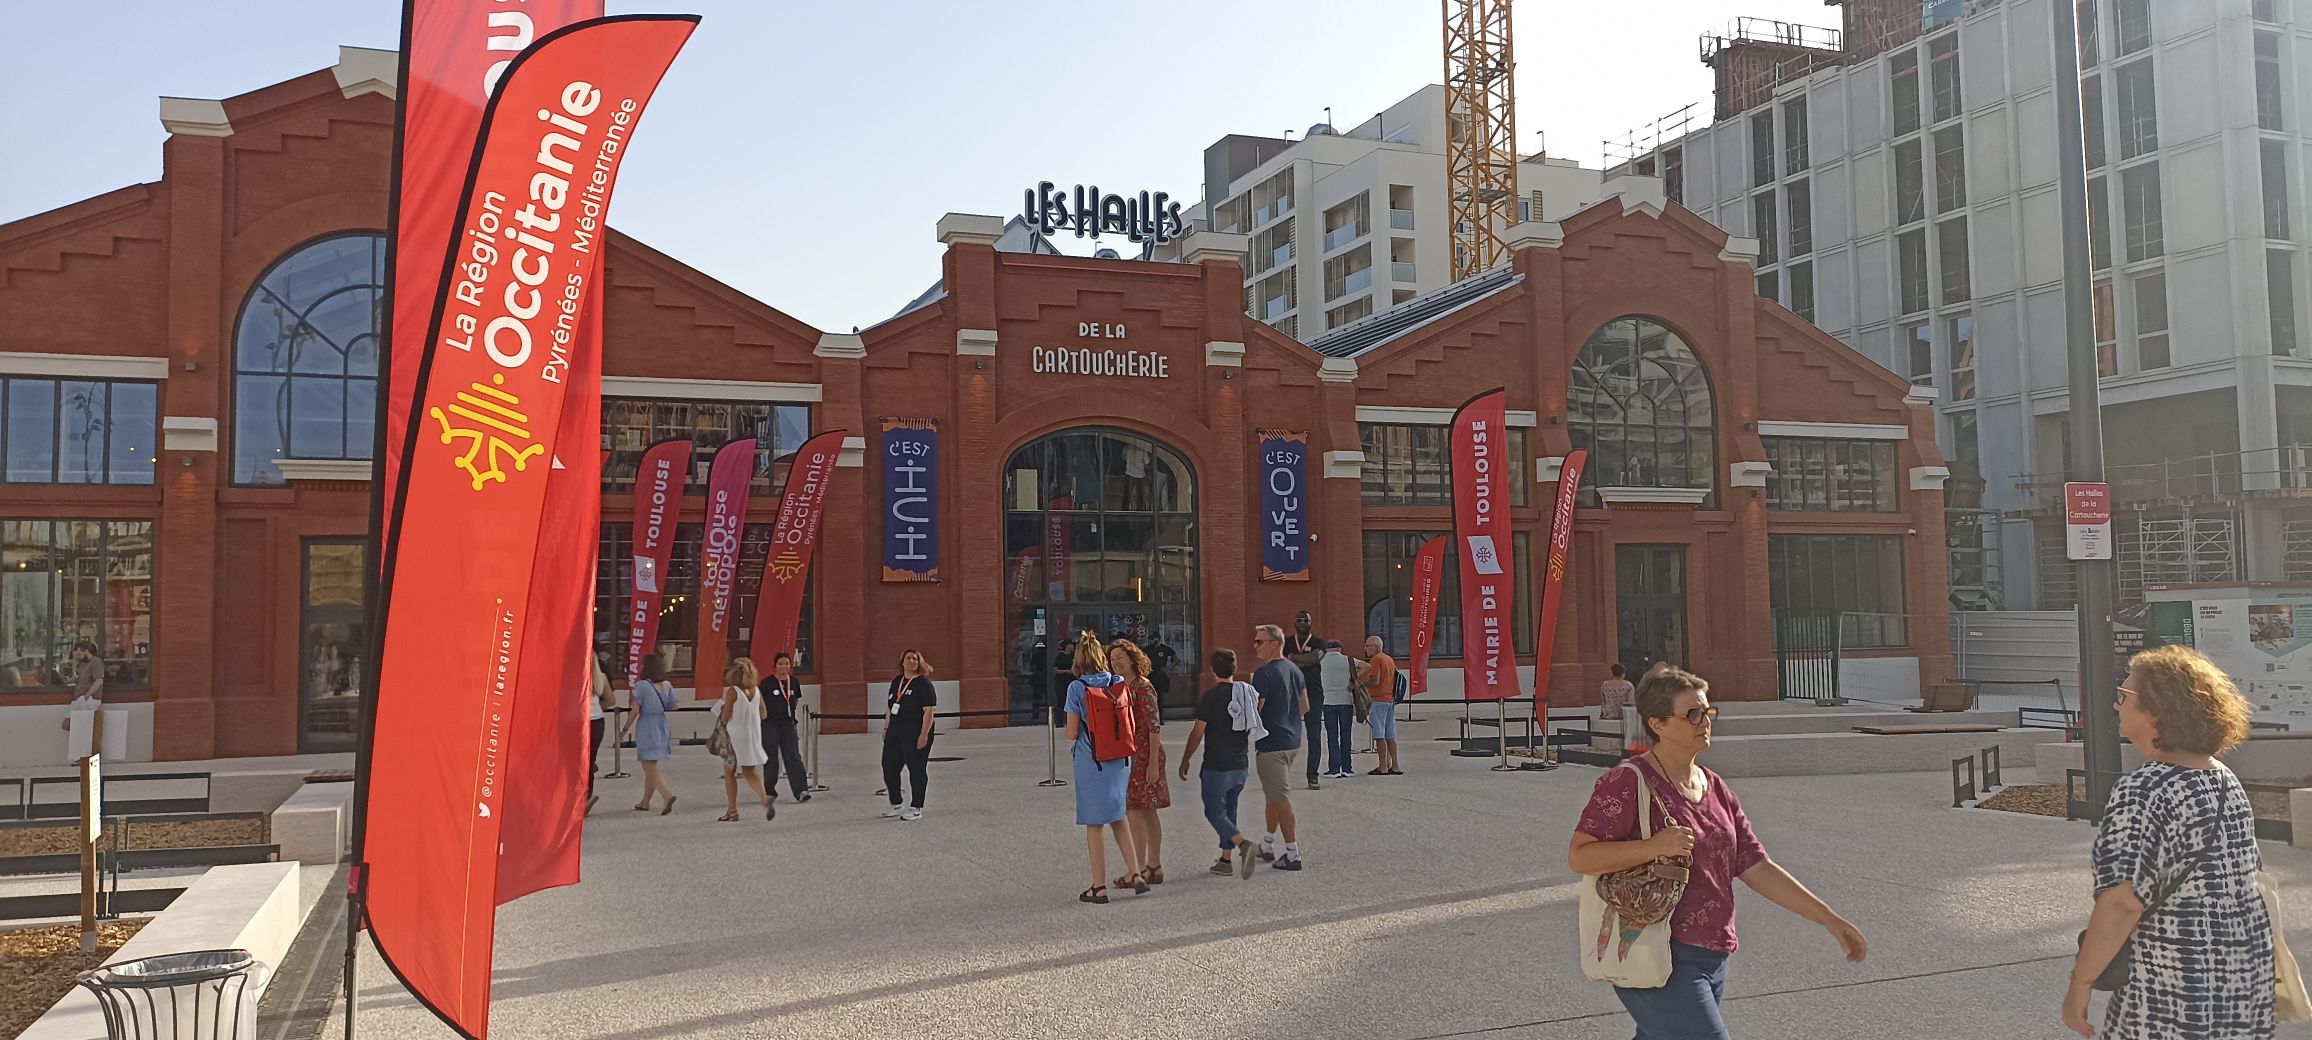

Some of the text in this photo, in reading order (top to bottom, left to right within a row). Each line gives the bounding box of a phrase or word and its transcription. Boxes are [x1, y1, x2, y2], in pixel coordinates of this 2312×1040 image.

[483, 80, 602, 369] Occitanie
[541, 272, 583, 384] Pyrénées
[571, 98, 638, 254] Méditerranée
[1024, 181, 1183, 245] LES HALLES
[445, 190, 506, 353] La Région
[1032, 346, 1169, 378] CARTOUCHERIE
[1078, 322, 1126, 339] DE LA
[889, 441, 930, 456] C'EST
[1266, 451, 1300, 465] C'EST
[775, 493, 796, 544] La Région
[787, 453, 825, 545] Occitanie
[1558, 468, 1576, 549] Occitanie
[2069, 511, 2109, 519] Cartoucherie
[2075, 489, 2085, 497] Les
[628, 459, 670, 687] MAIRIE DE TOULOUSE
[1472, 420, 1499, 685] MAIRIE DE TOULOUSE
[481, 713, 501, 798] @occitanie
[493, 610, 515, 696] laregion.fr
